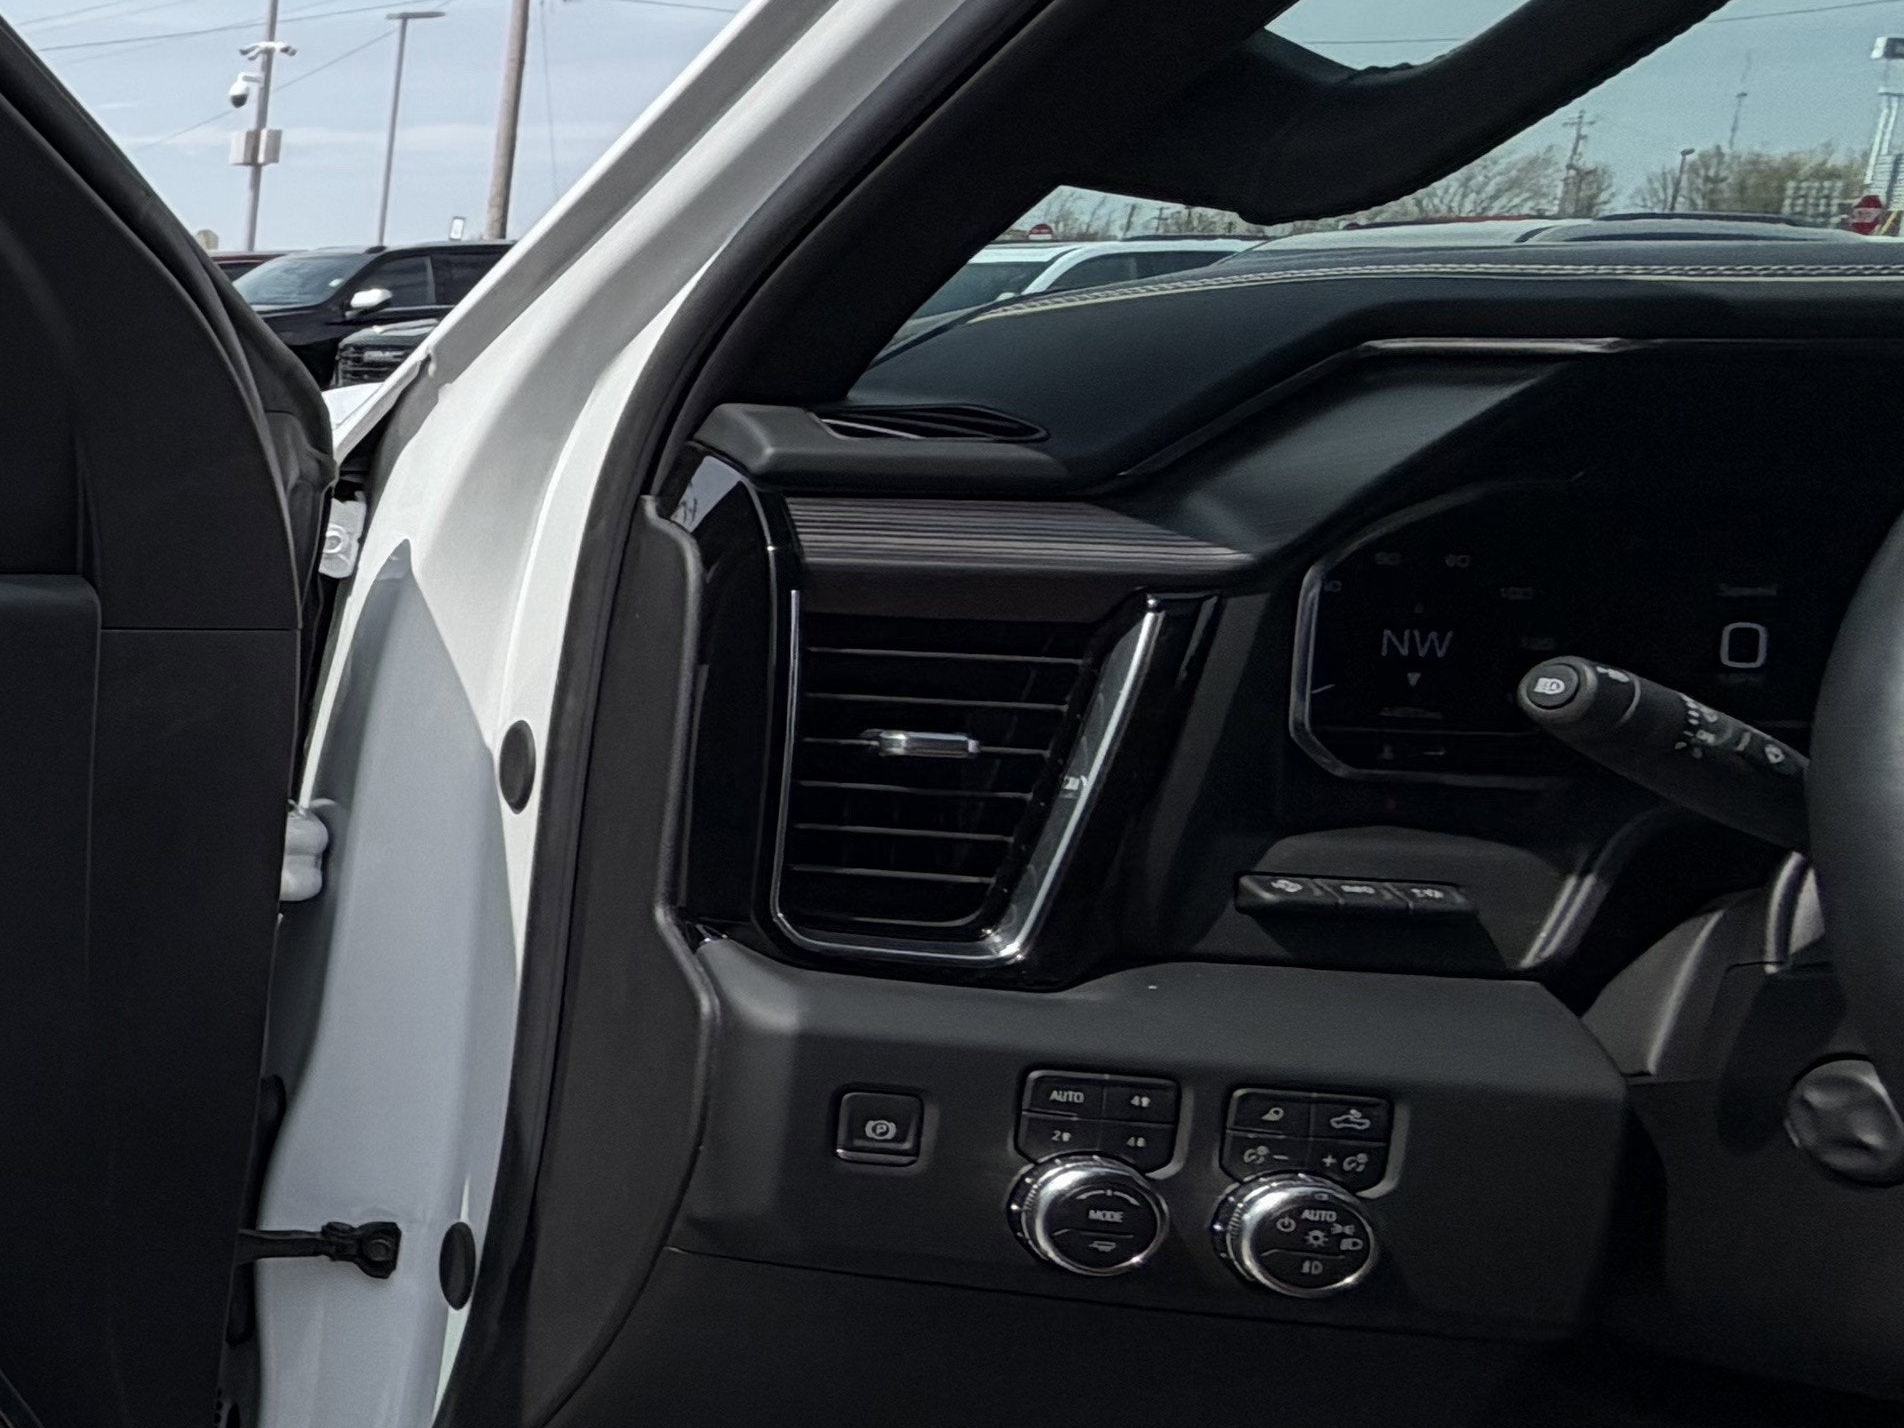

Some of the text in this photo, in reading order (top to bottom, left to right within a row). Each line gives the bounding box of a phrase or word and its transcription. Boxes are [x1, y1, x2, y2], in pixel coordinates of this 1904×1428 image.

[1380, 628, 1456, 658] NW
[1719, 621, 1770, 669] 0
[1049, 1090, 1085, 1104] AUTO
[1088, 1209, 1124, 1223] MODE
[1301, 1209, 1338, 1222] AUTO
